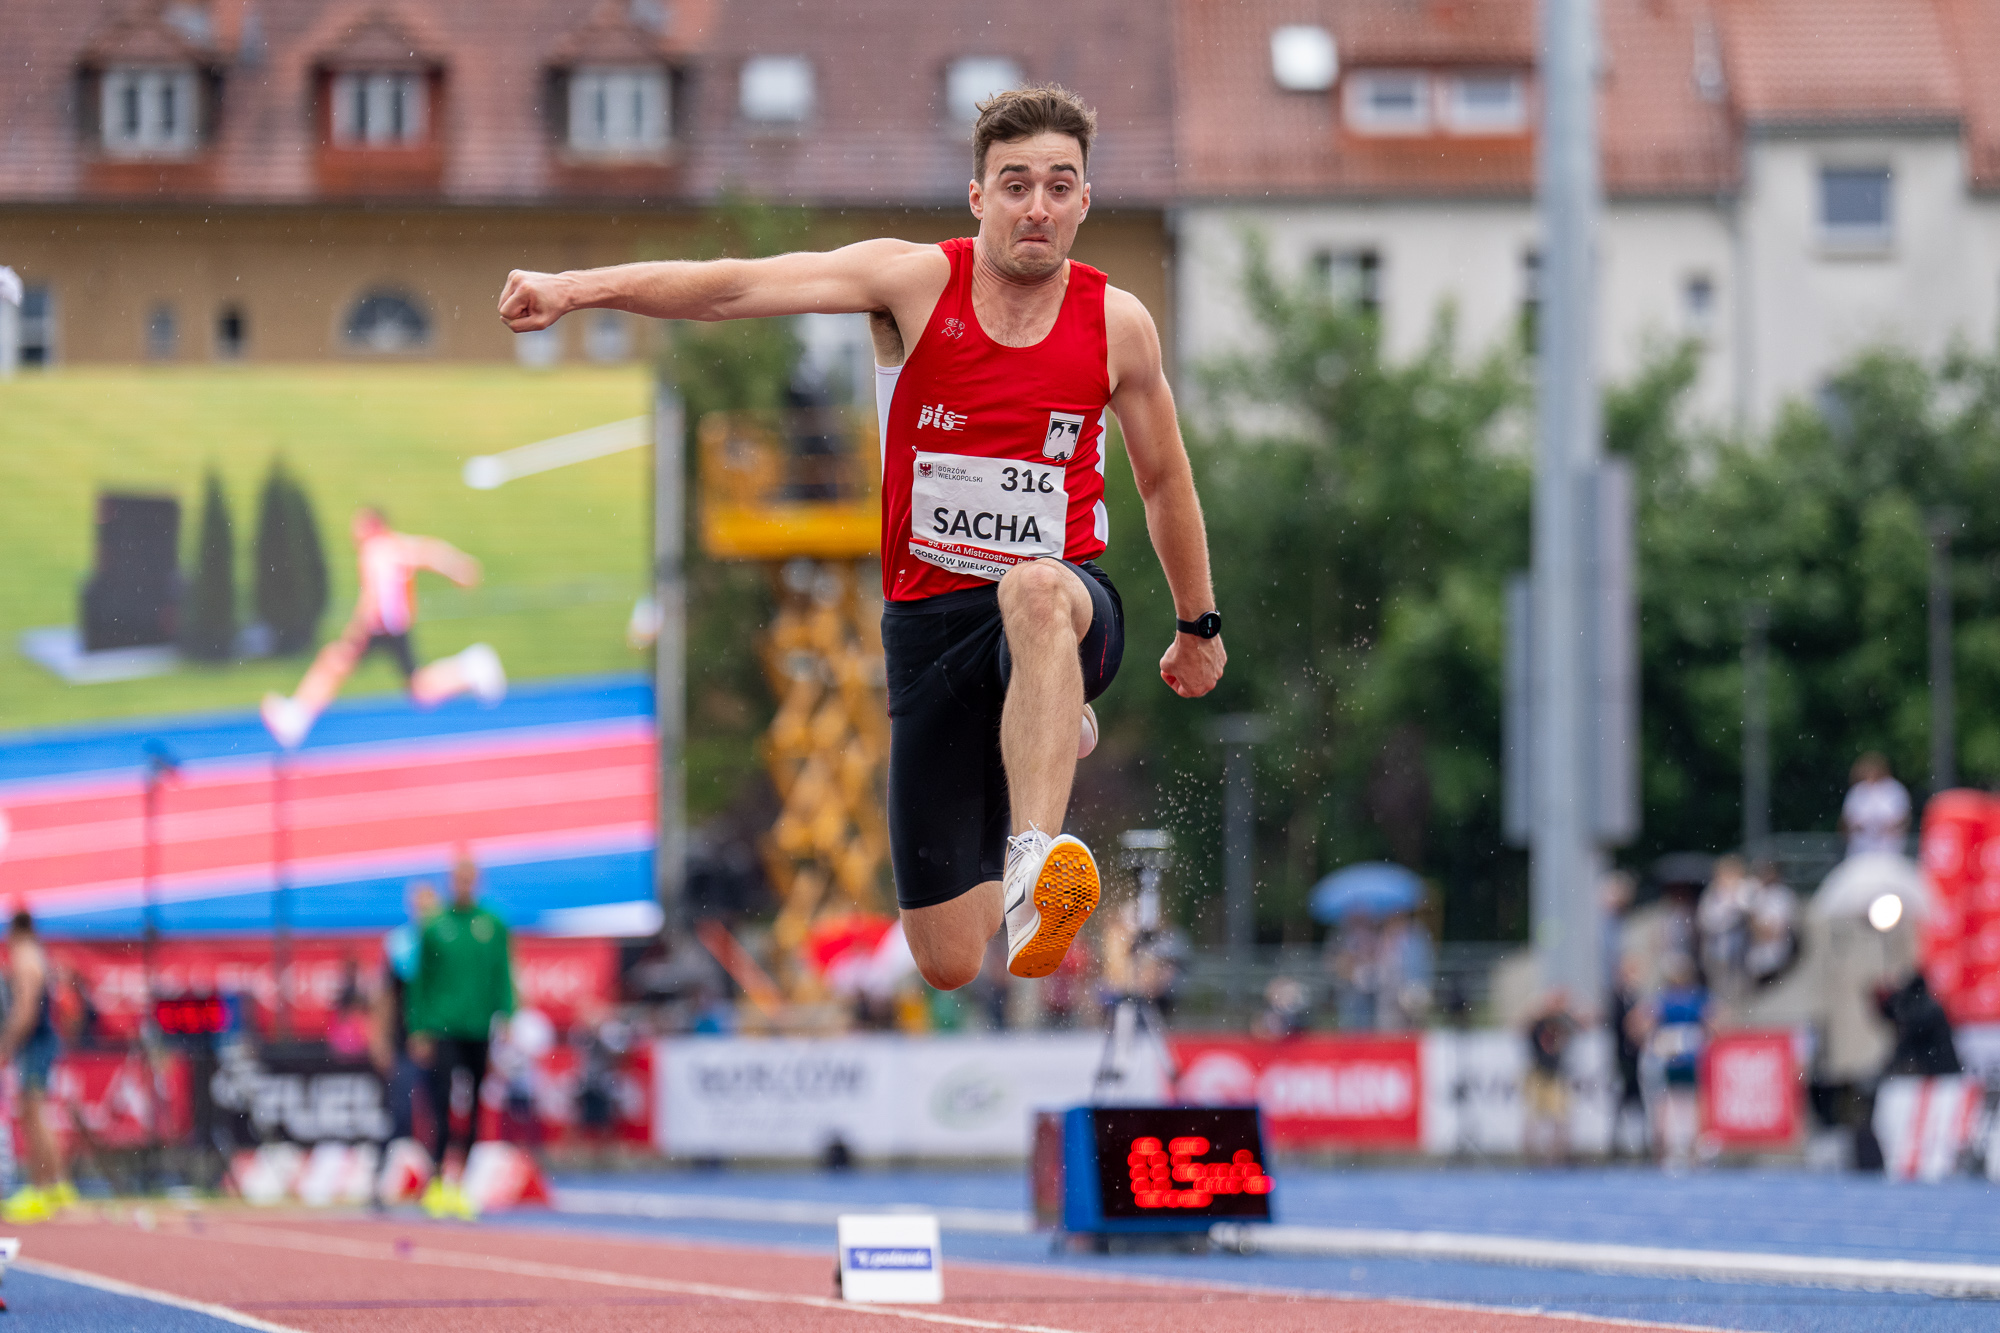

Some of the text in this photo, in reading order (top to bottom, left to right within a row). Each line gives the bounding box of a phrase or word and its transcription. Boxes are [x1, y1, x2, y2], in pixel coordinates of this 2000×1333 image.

[937, 465, 967, 475] GORZÓW
[937, 472, 983, 483] WIELKOPOLSKI
[1000, 467, 1055, 494] 316
[932, 507, 1042, 542] SACHA
[914, 548, 956, 566] GORZÓW
[957, 559, 1009, 576] WIELKOPO
[941, 543, 962, 553] PZLA
[963, 547, 1016, 564] Mistrzostwa
